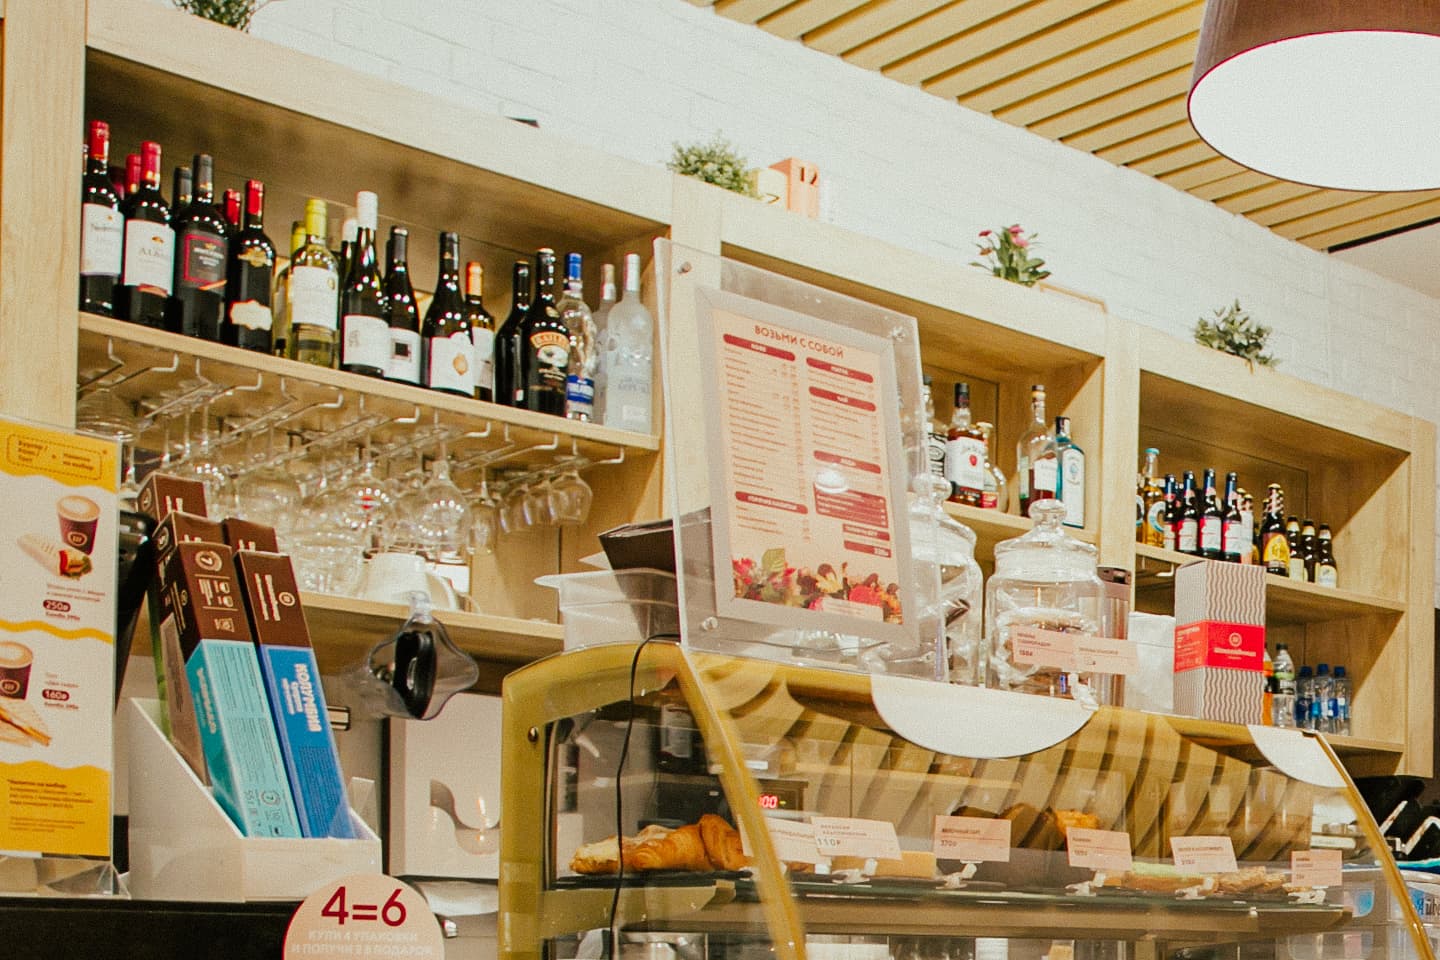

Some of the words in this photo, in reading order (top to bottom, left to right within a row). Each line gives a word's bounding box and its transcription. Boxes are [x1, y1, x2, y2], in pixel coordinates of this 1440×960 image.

[754, 325, 798, 345] ВОЗЬМИ
[799, 338, 807, 348] С
[808, 341, 845, 359] СОБОЙ
[321, 886, 407, 927] 4=6
